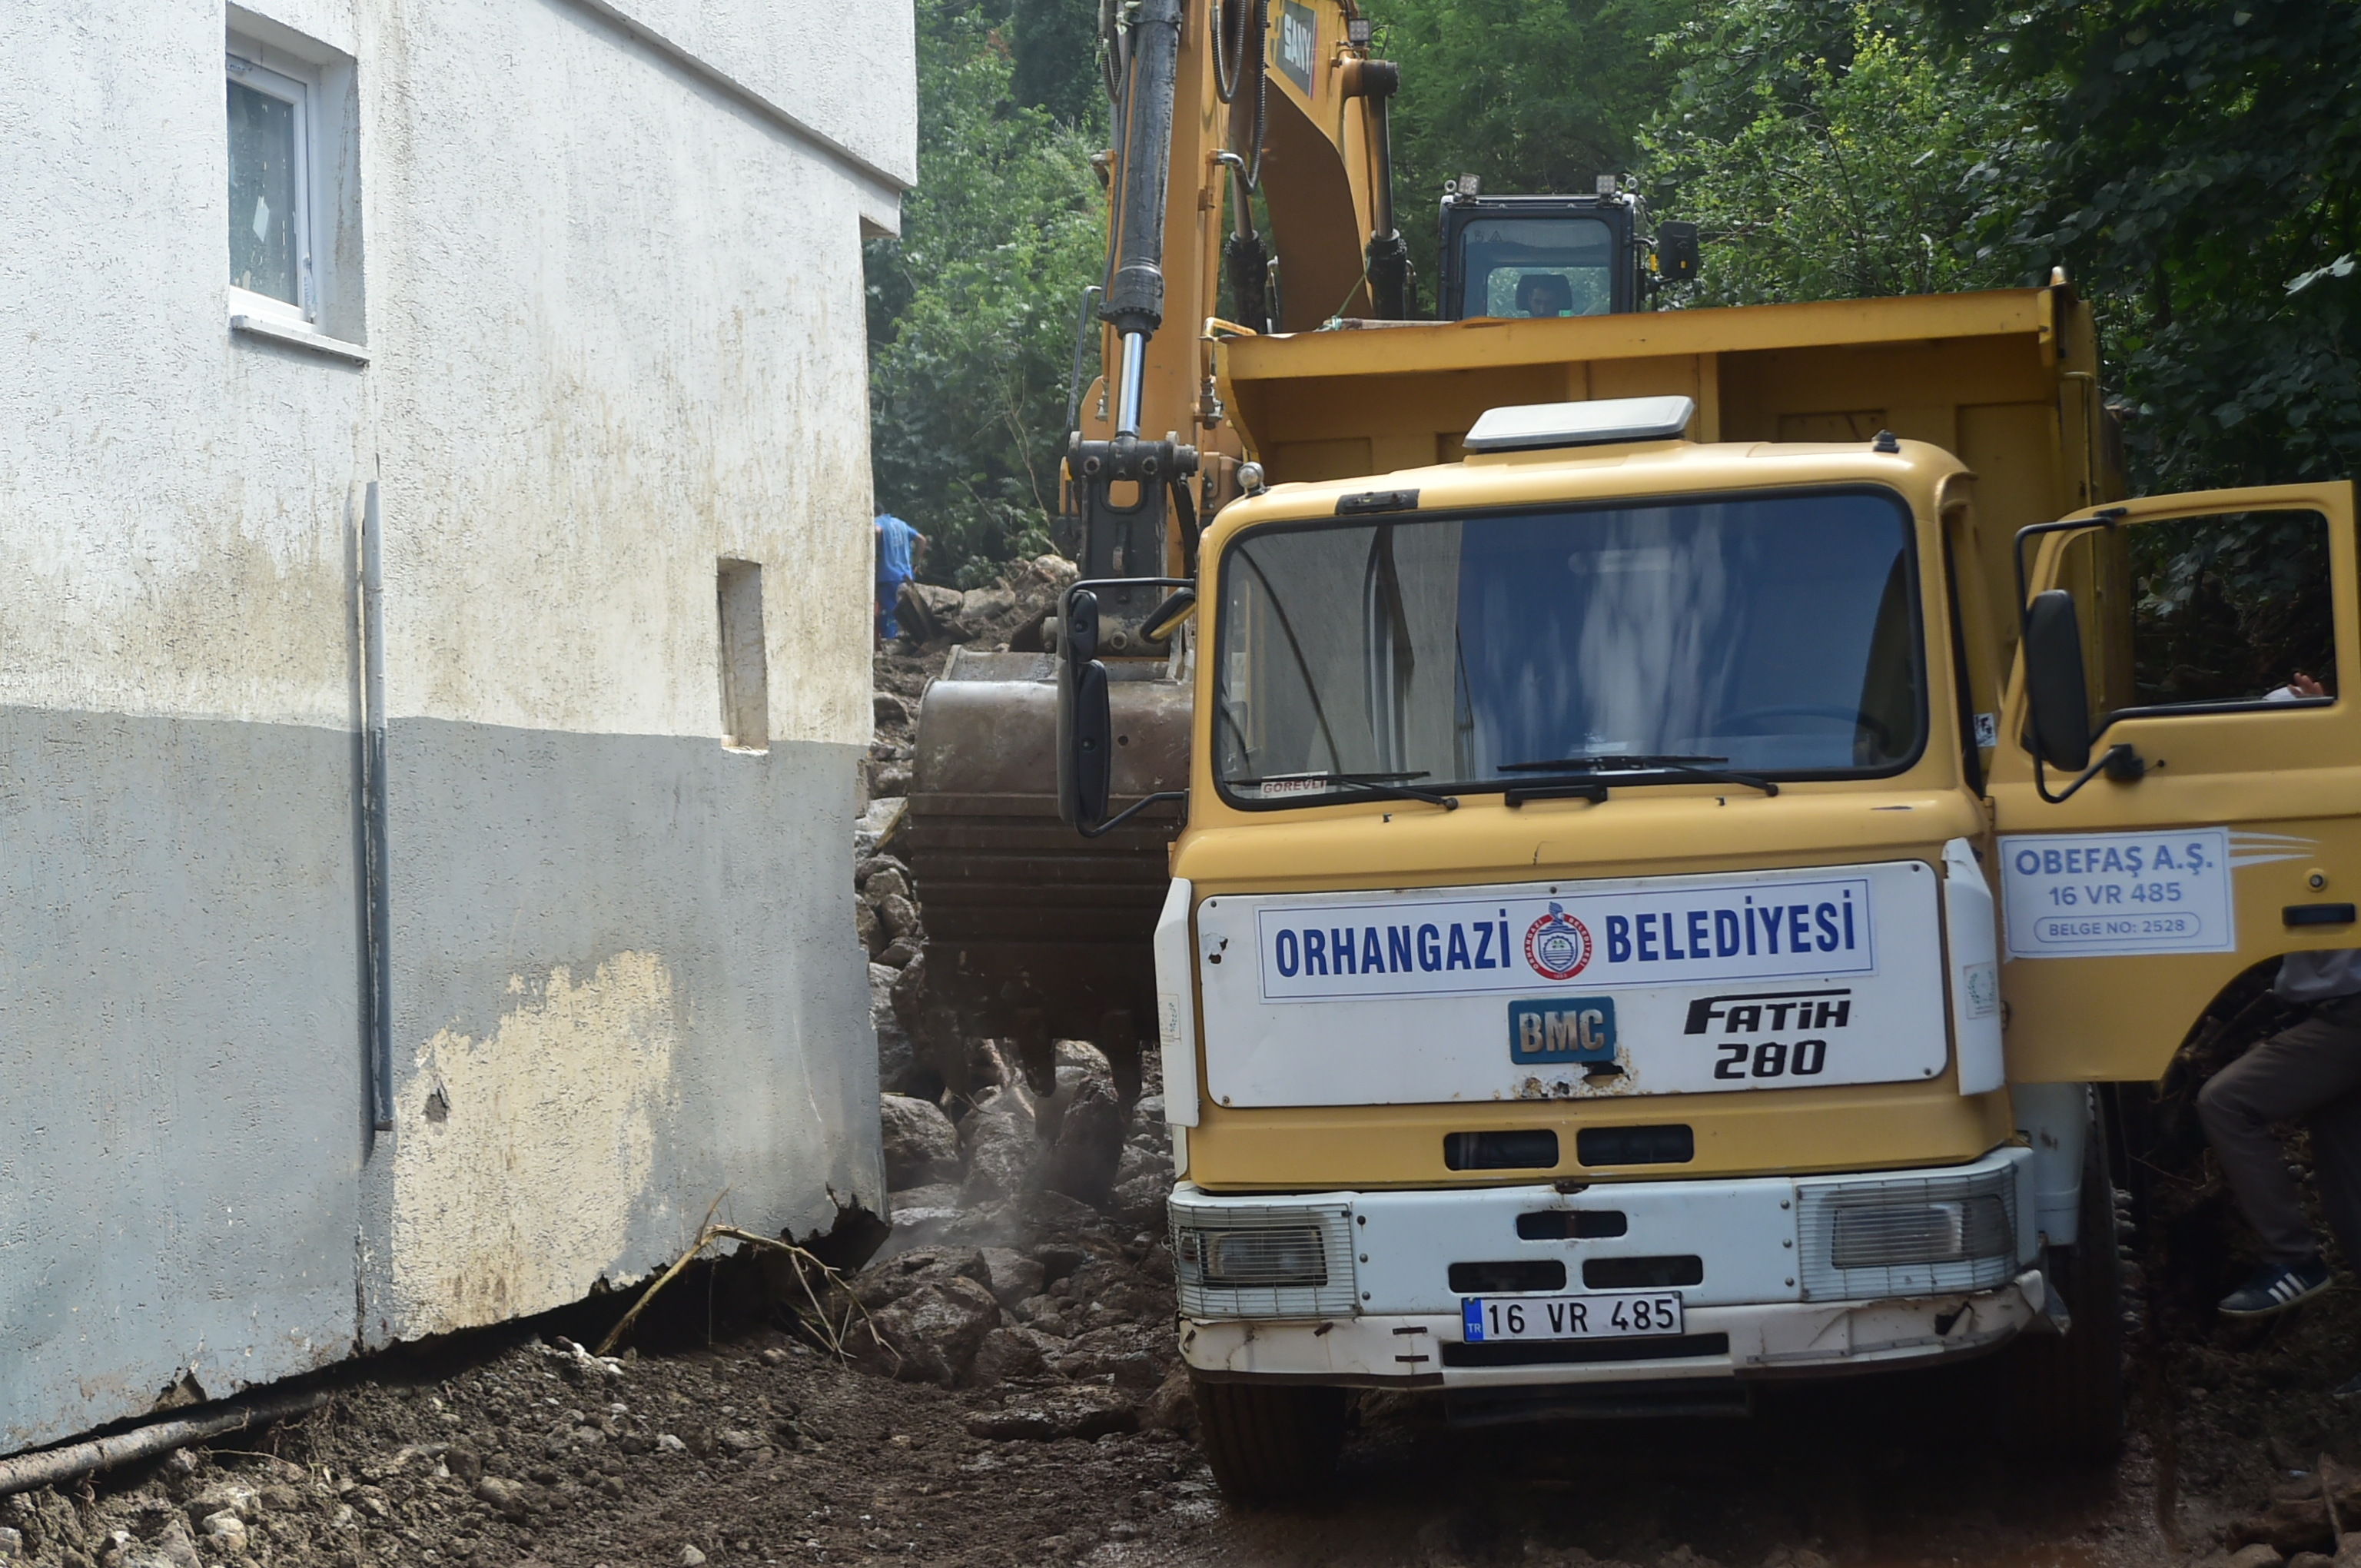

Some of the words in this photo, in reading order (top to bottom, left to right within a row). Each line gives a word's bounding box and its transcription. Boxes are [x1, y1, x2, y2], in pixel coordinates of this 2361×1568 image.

[1284, 13, 1311, 75] SANY
[2015, 845, 2143, 878] OBEFAŞ
[2152, 842, 2213, 875] A.Ş.
[2048, 886, 2077, 905] 16
[2084, 885, 2121, 904] VR
[2130, 882, 2182, 902] 485
[1276, 909, 1511, 977] ORHANGAZİ
[1606, 889, 1855, 963] BELEDİYESİ
[2049, 922, 2100, 936] BELGE
[2107, 921, 2137, 935] NO:
[2143, 919, 2185, 933] 2528
[1519, 1008, 1605, 1053] BMC
[1714, 1039, 1826, 1079] 280
[1467, 1323, 1482, 1334] TR
[1489, 1304, 1525, 1334] 16
[1546, 1302, 1589, 1333] VR
[1611, 1299, 1673, 1330] 485
